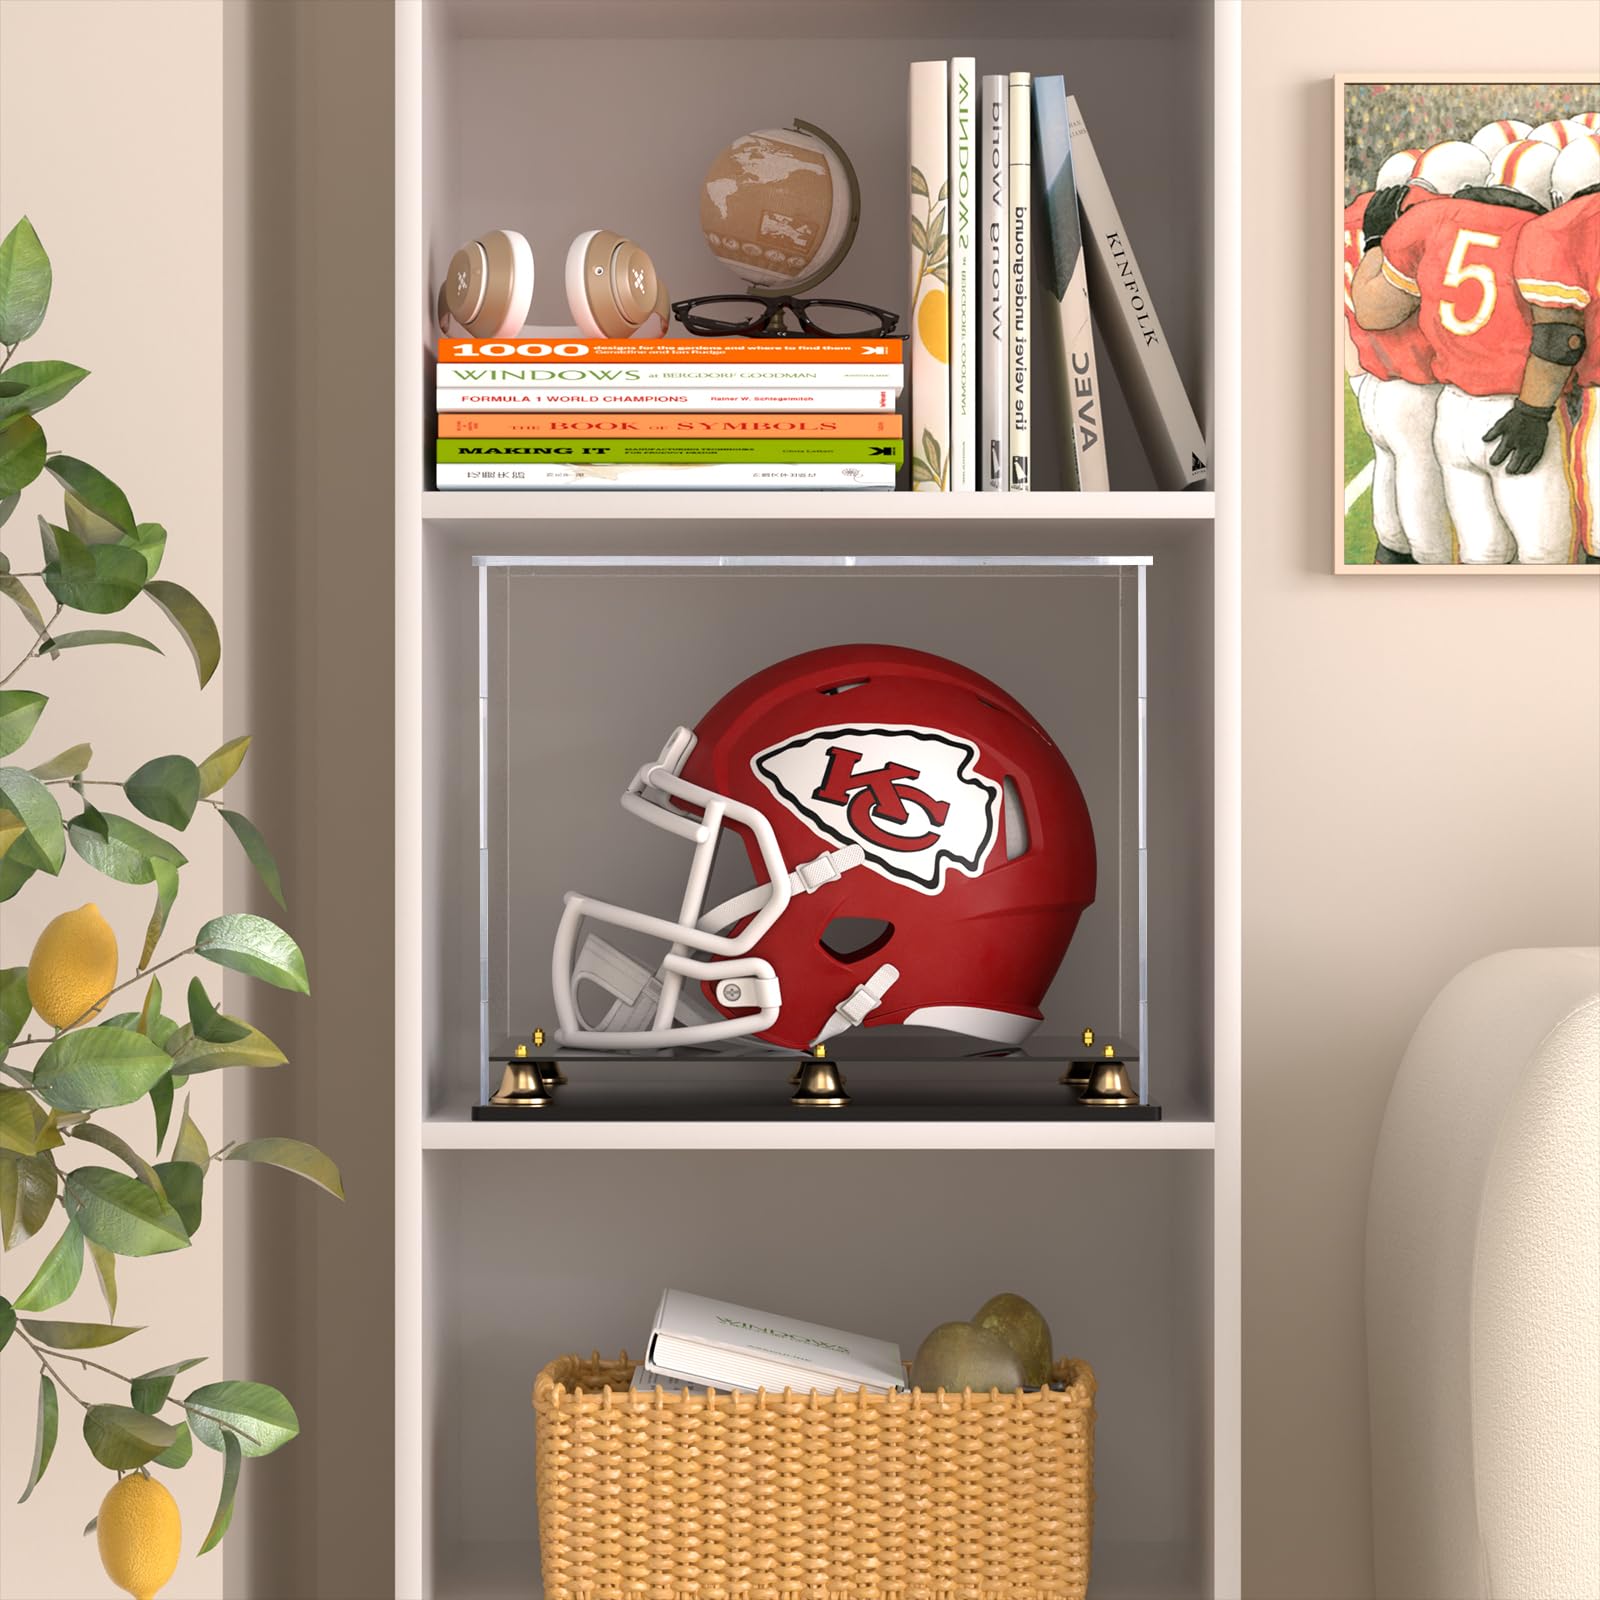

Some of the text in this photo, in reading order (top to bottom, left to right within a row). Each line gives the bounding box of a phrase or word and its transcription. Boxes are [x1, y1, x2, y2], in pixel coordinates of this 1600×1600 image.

[1106, 231, 1159, 348] KINFOLK
[1438, 228, 1502, 336] 5
[453, 344, 590, 356] 1000
[453, 370, 640, 381] WINDOWS
[550, 422, 640, 431] BOOK
[677, 422, 837, 431] SYMBOLS
[458, 447, 611, 455] MAKING IT
[811, 746, 951, 853] KC
[716, 1315, 850, 1354] WINDOWS
